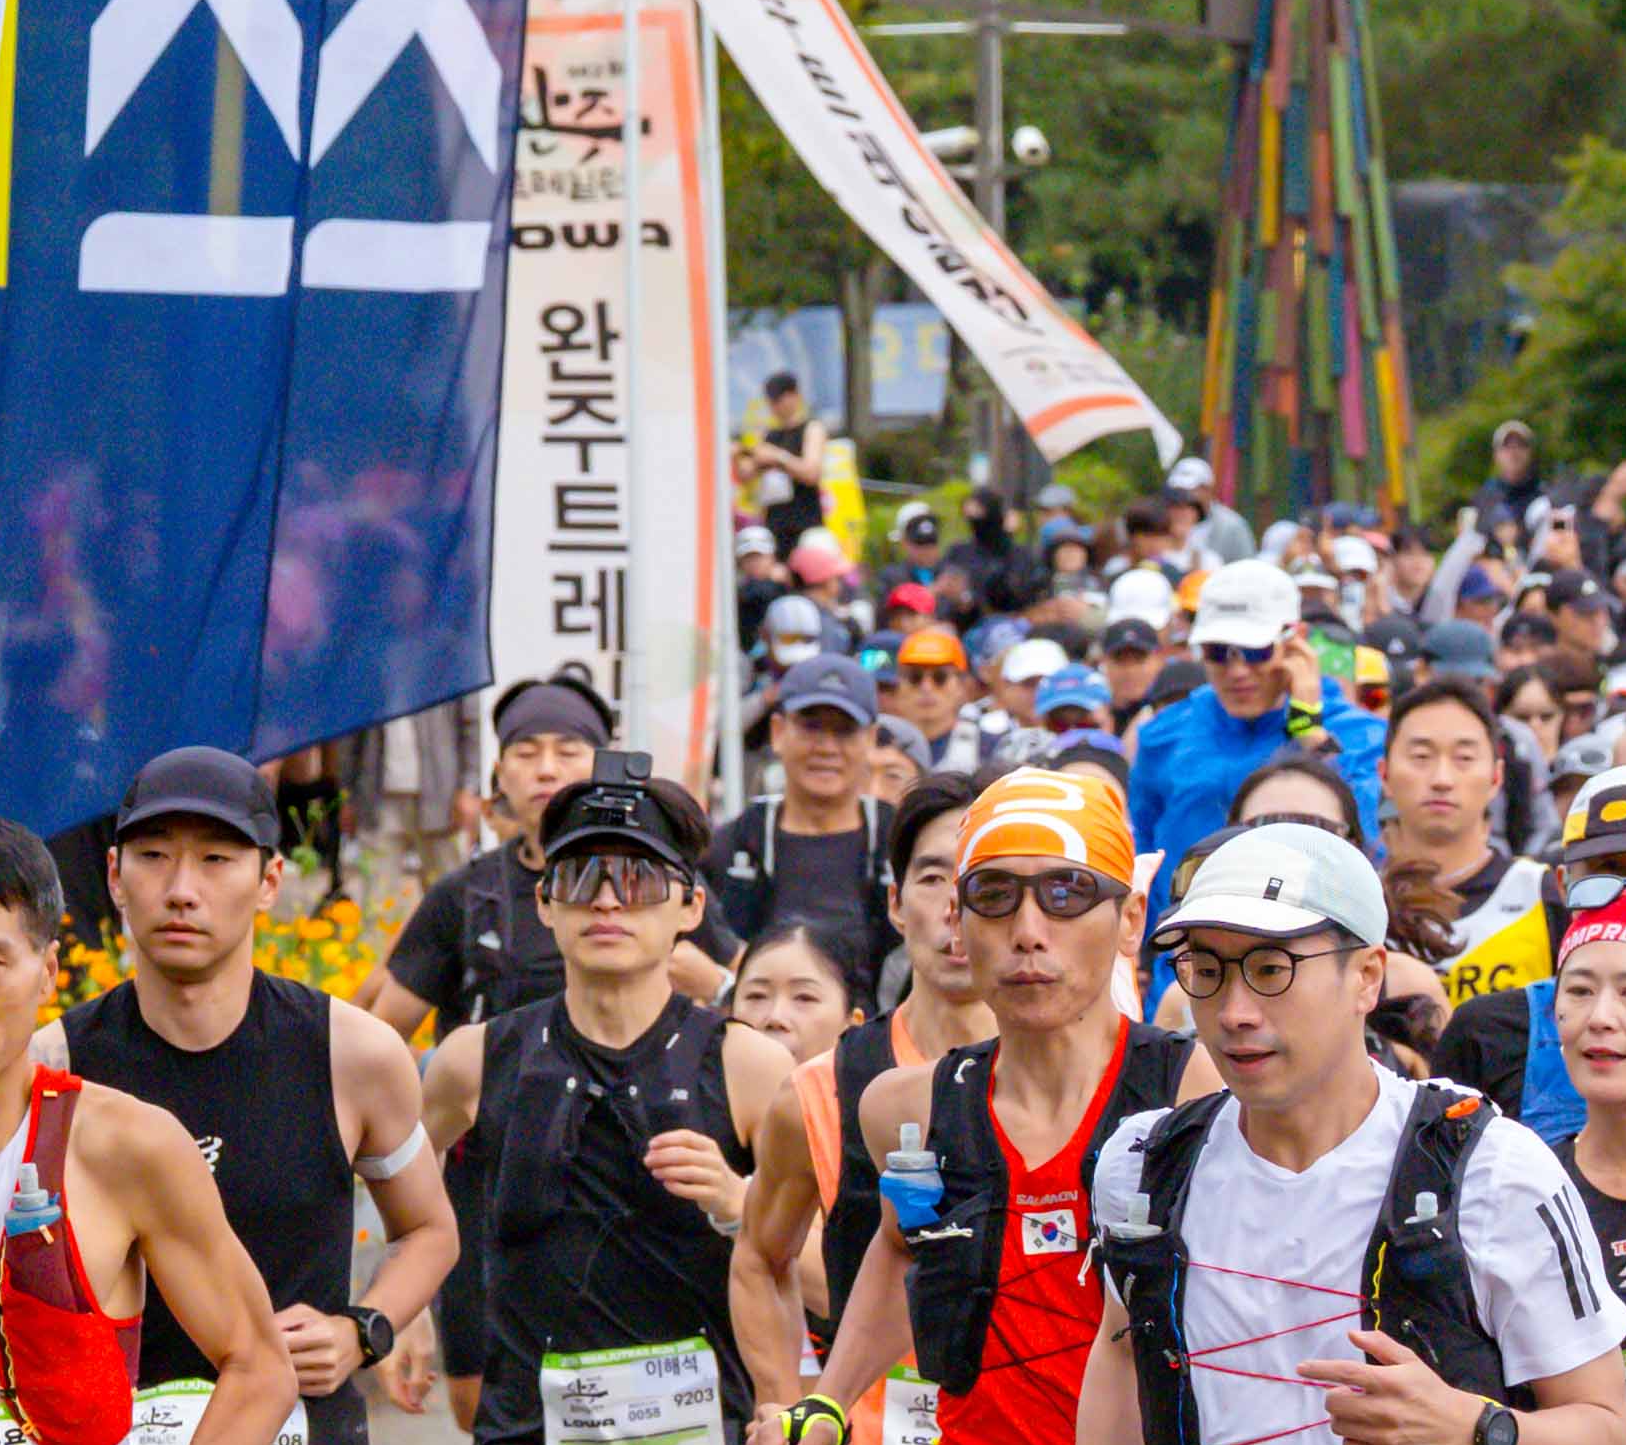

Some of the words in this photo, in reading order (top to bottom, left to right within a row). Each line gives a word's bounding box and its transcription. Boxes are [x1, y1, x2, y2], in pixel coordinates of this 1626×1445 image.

[512, 221, 671, 249] OWA
[645, 1354, 699, 1378] 이해석
[673, 1387, 715, 1407] 9203
[562, 1418, 616, 1428] LOWA
